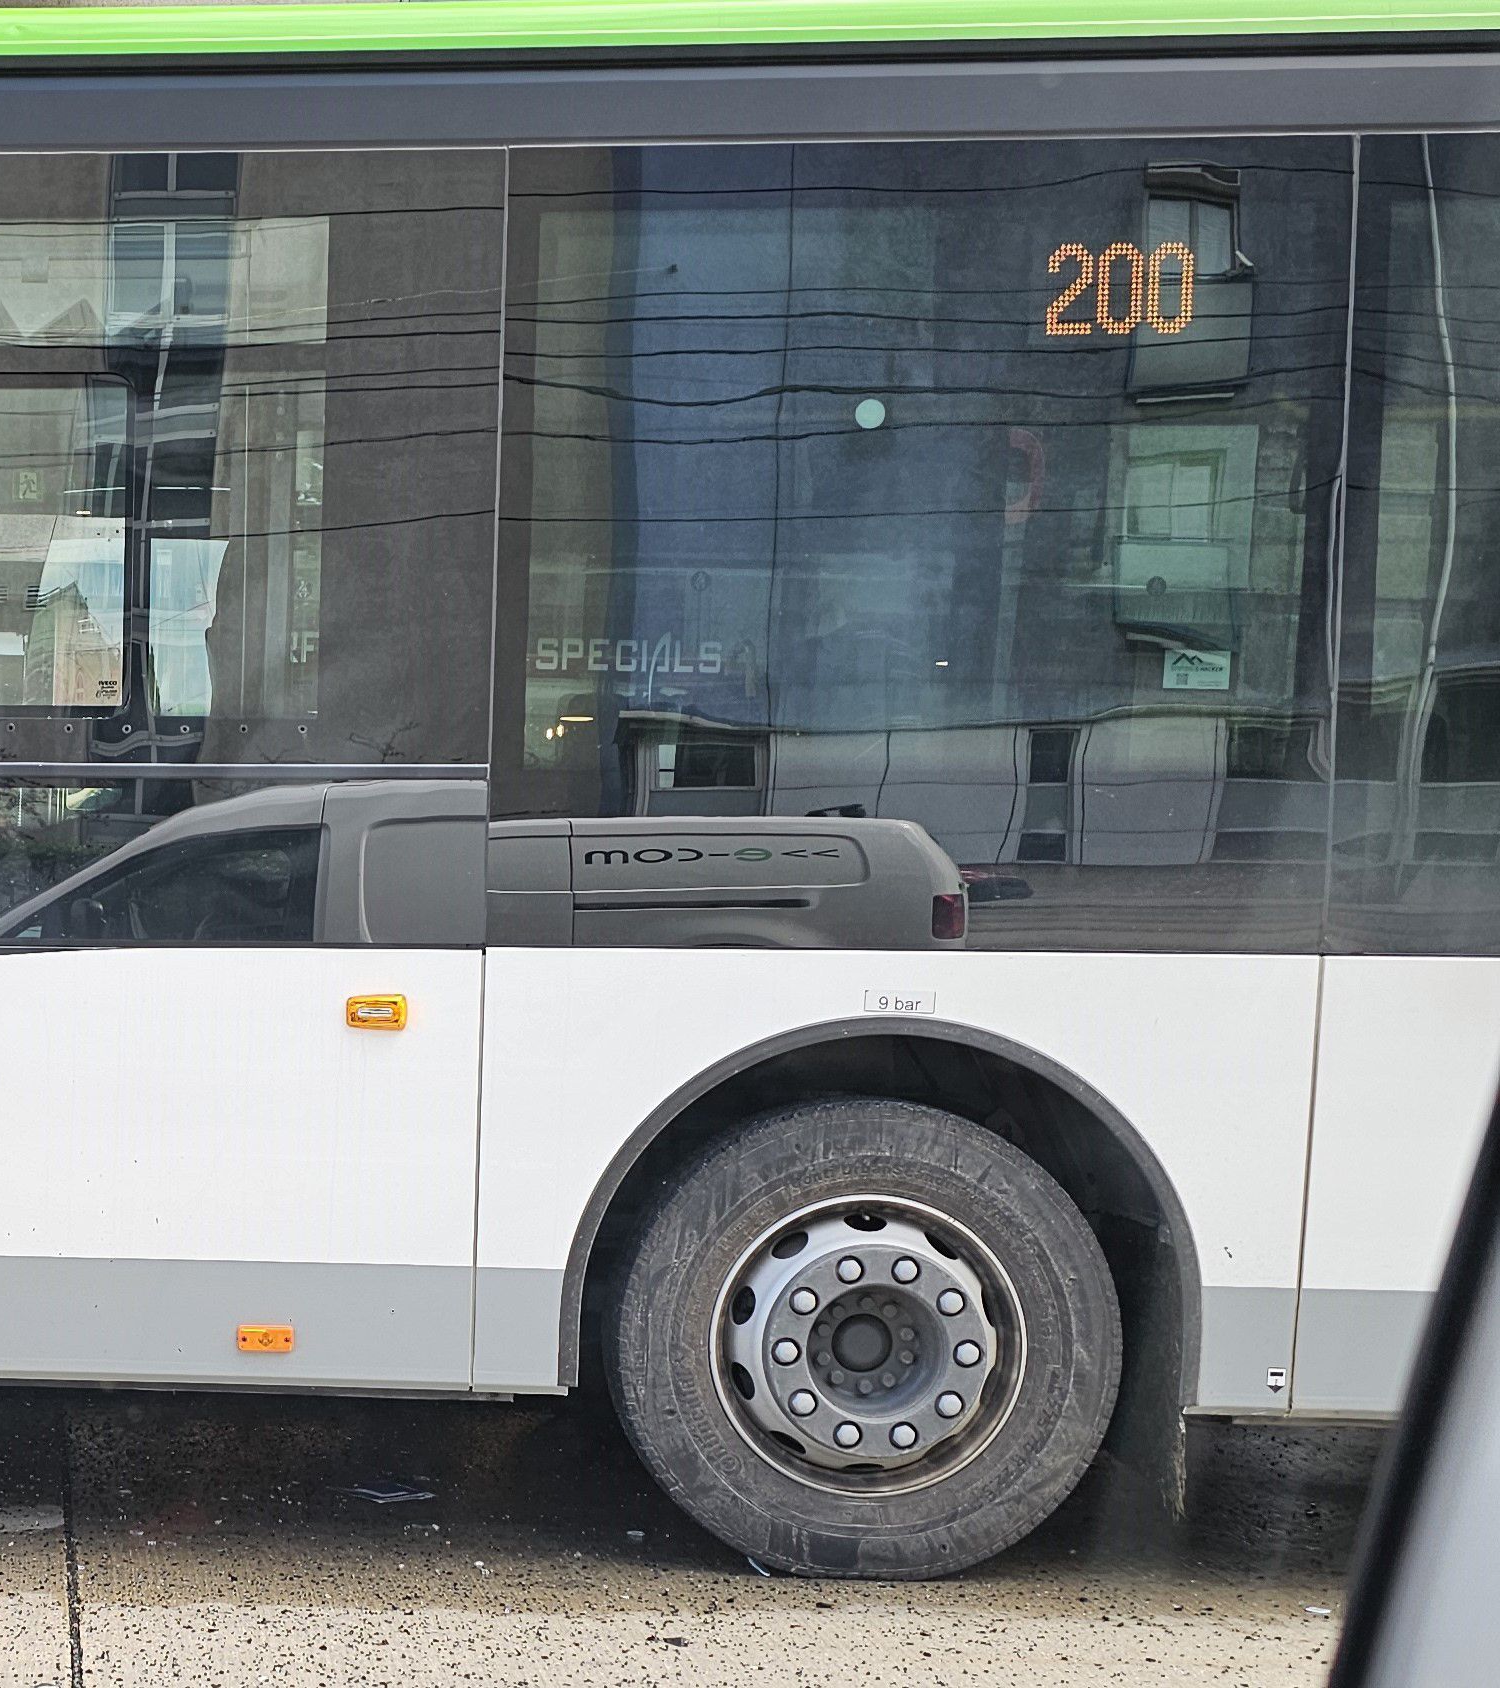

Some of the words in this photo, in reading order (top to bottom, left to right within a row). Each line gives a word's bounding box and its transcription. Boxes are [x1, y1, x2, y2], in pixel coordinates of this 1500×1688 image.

[1046, 242, 1195, 336] 200
[534, 632, 723, 677] SPECIALS
[878, 995, 889, 1010] 9
[894, 996, 922, 1011] bar
